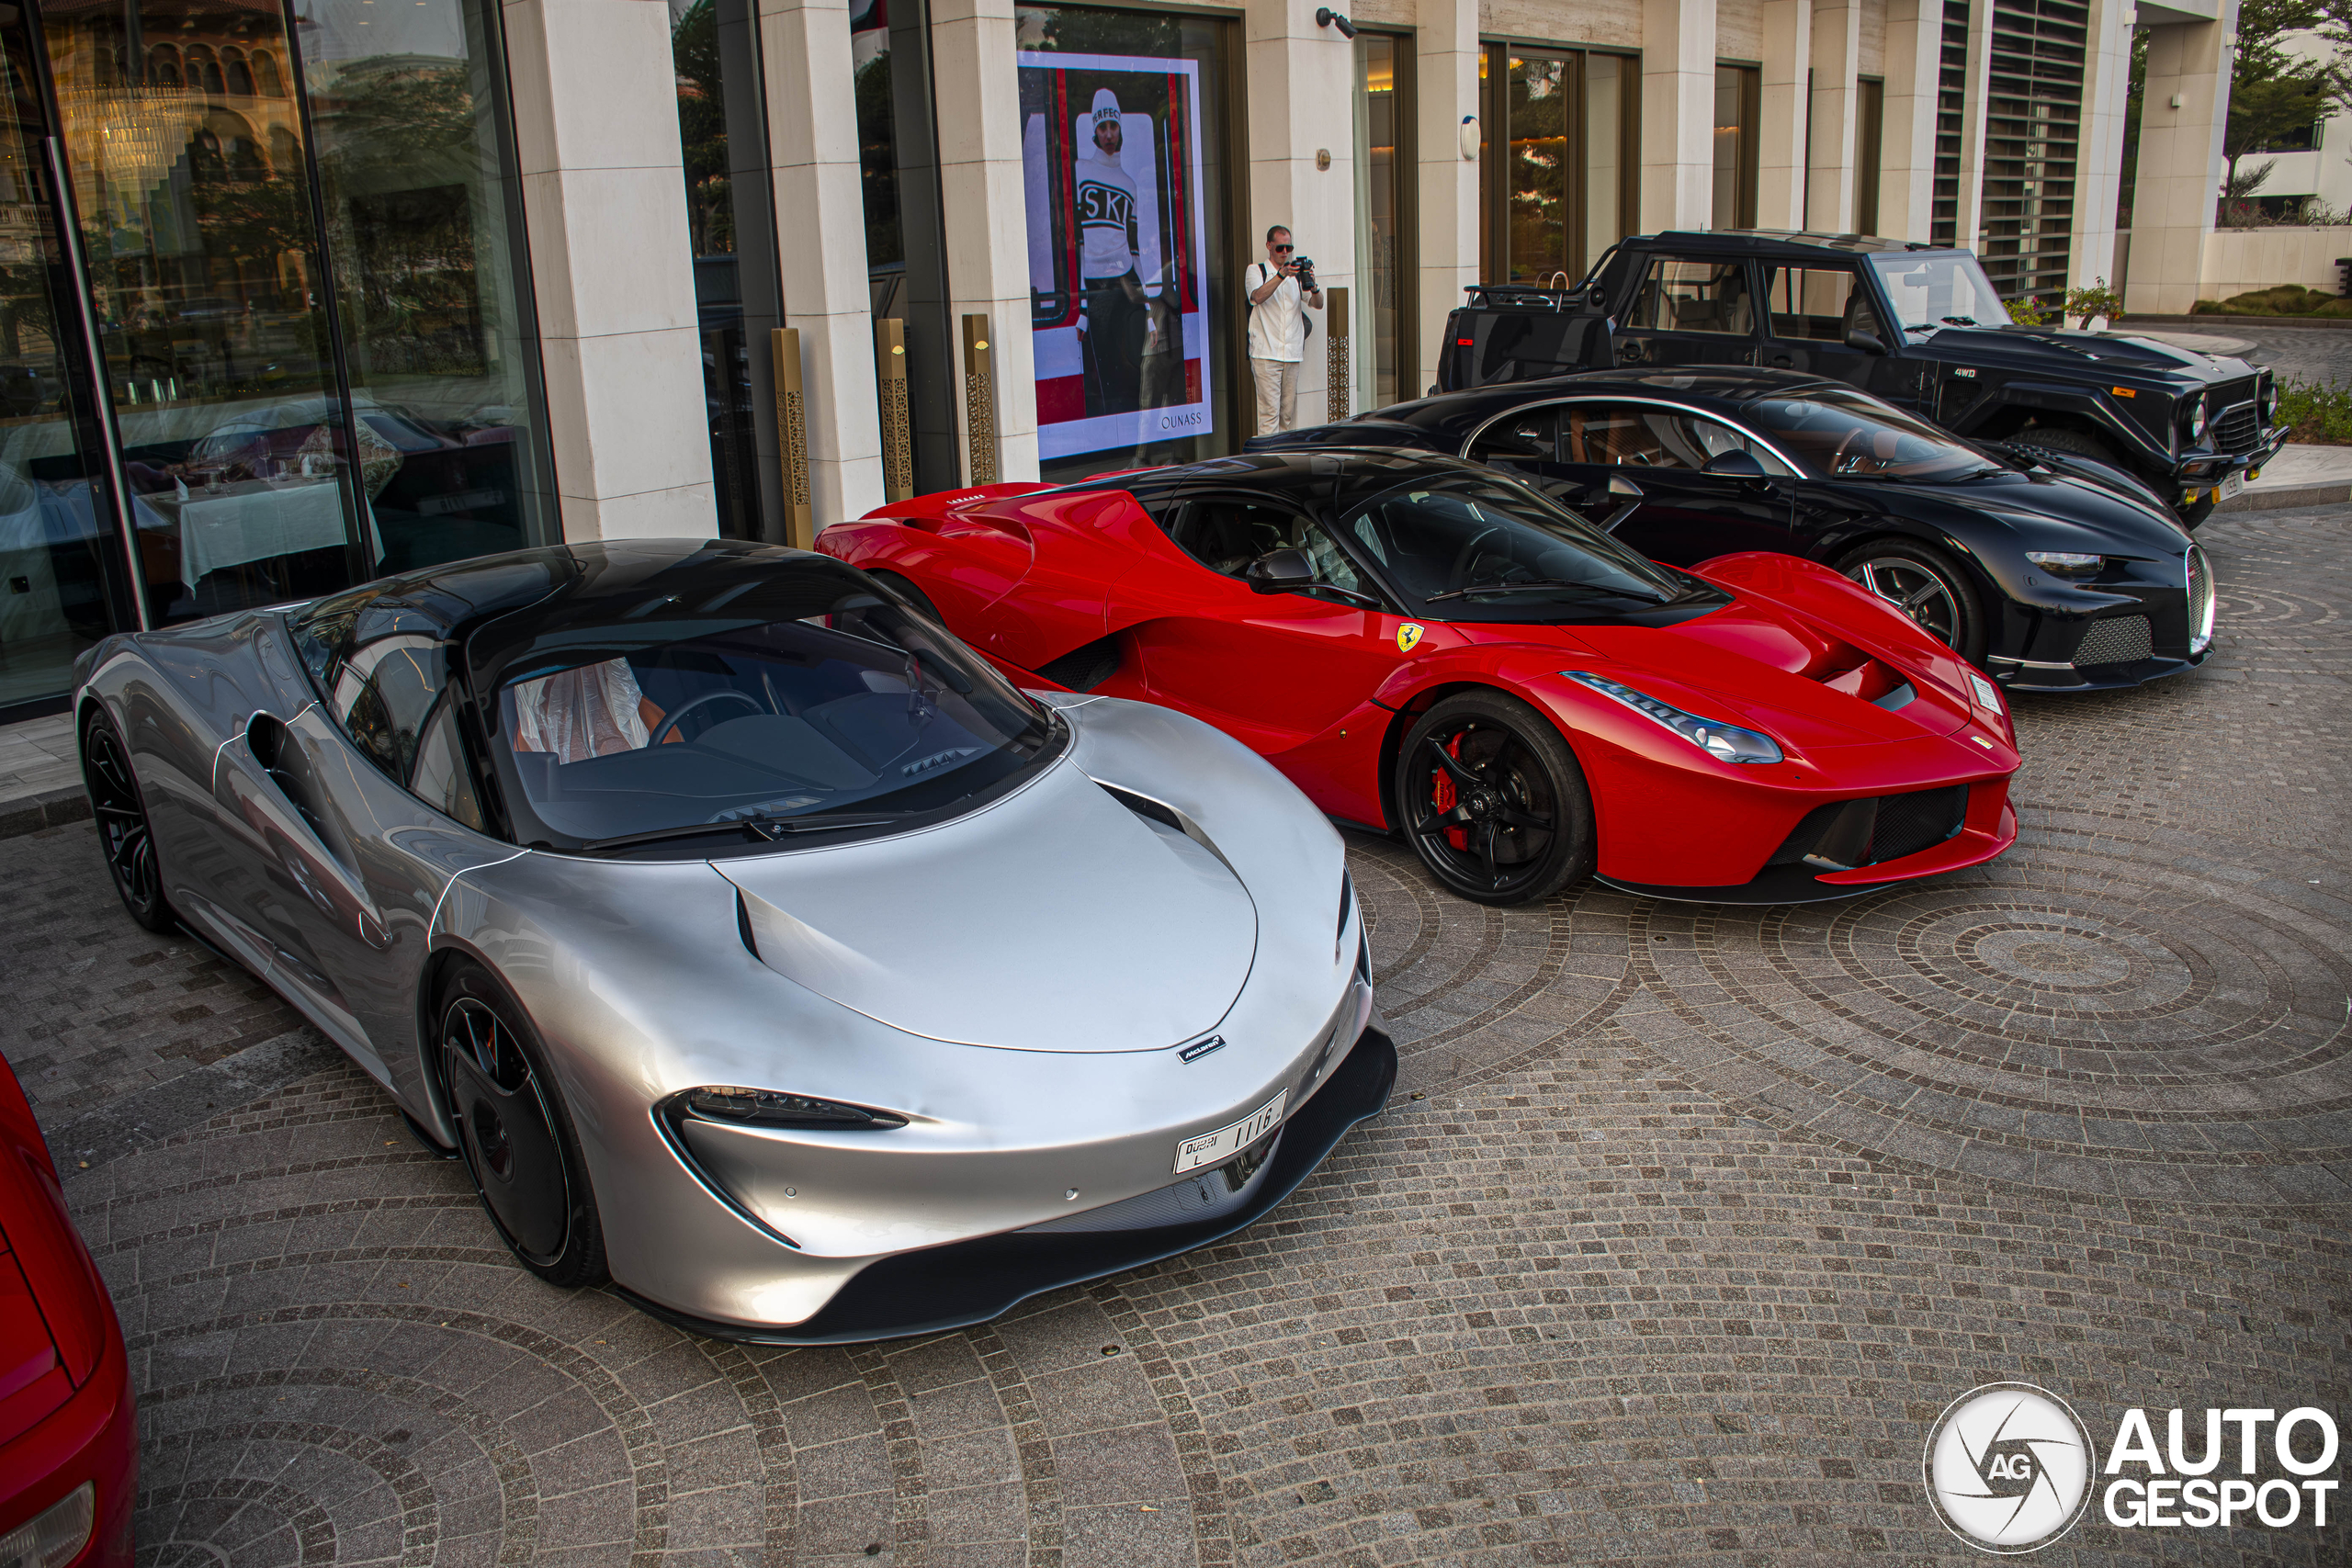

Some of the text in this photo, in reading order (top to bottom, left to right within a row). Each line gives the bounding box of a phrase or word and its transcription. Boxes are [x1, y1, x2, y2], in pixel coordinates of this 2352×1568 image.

[1085, 187, 1128, 223] SKI
[1954, 367, 1976, 378] 4WD
[1161, 412, 1202, 430] OUNASS
[1185, 1037, 1219, 1059] McLaren
[1234, 1107, 1272, 1149] 1116
